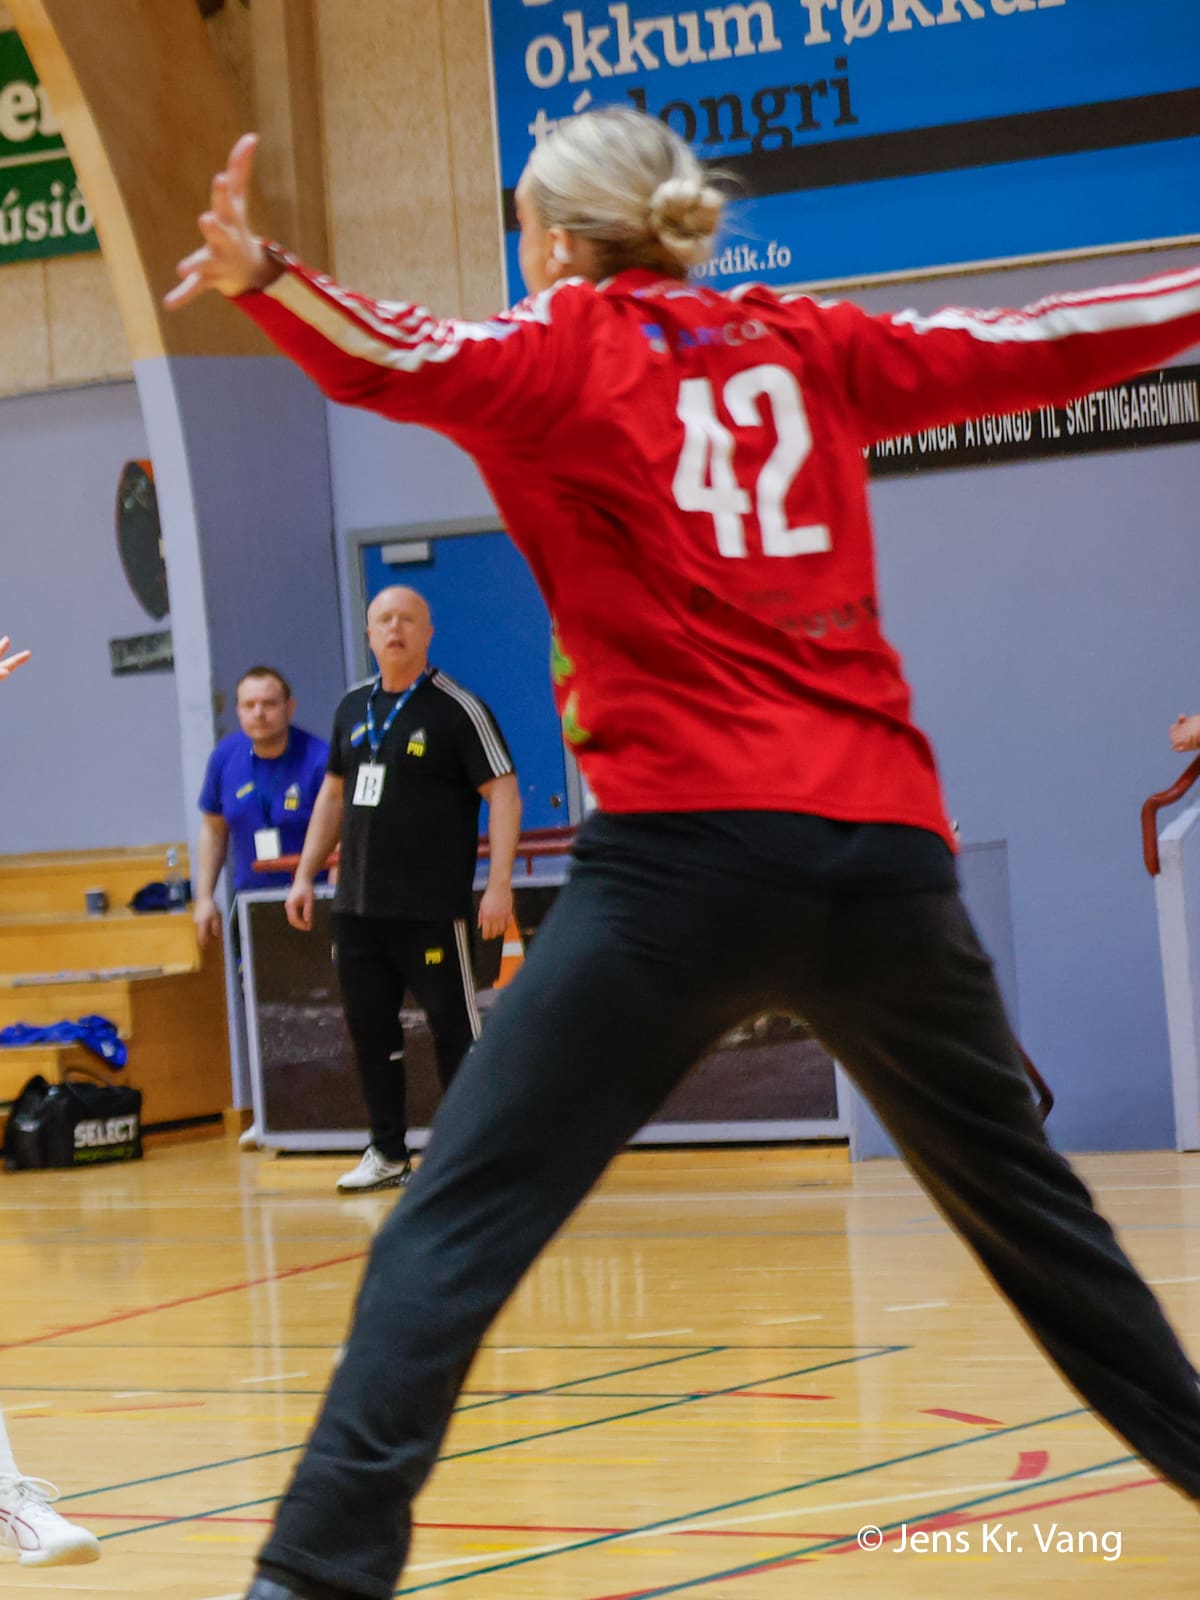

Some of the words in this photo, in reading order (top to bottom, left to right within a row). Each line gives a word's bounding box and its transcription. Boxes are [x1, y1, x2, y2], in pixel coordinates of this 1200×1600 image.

[525, 2, 781, 88] okkum
[800, 0, 1066, 46] røk
[1037, 402, 1061, 440] TIL
[672, 363, 832, 558] 42
[73, 1114, 138, 1149] SELECT
